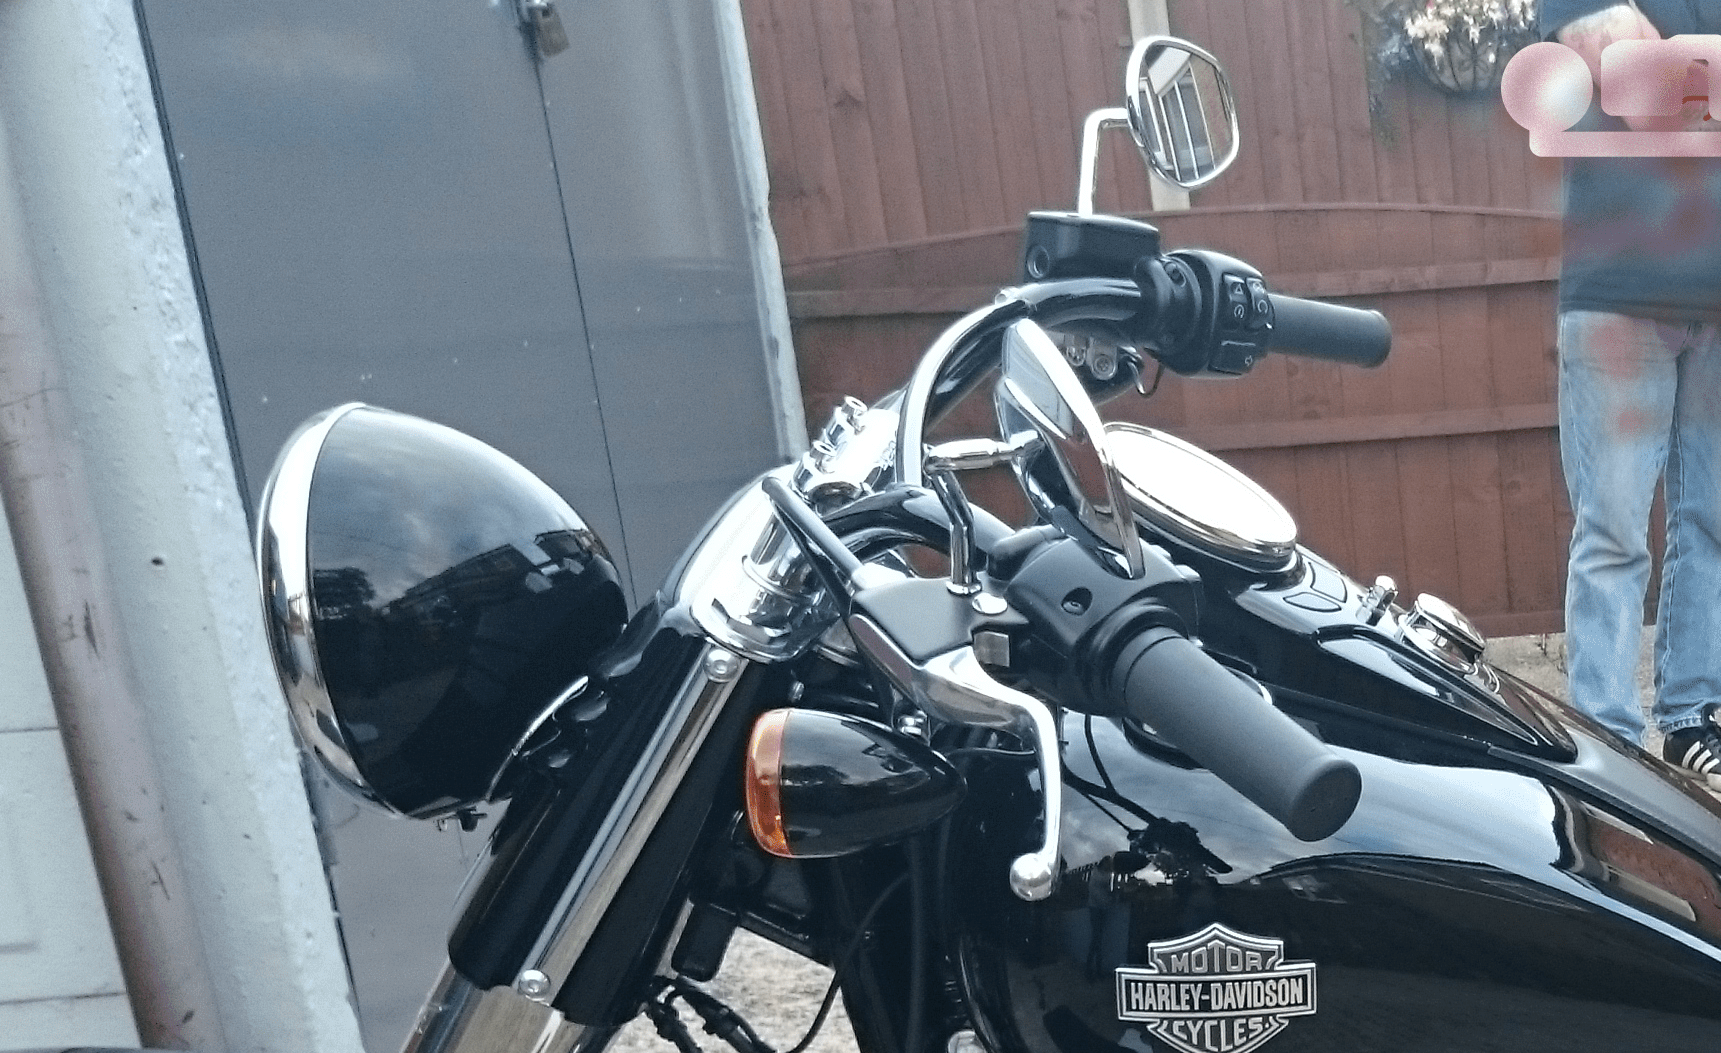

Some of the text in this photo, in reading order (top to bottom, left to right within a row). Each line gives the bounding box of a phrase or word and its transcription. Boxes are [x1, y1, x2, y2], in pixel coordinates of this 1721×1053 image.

[1171, 940, 1262, 974] MOTOR
[1130, 978, 1303, 1011] HARLEY-DAVIDSON
[1173, 1017, 1263, 1052] CYCLES
